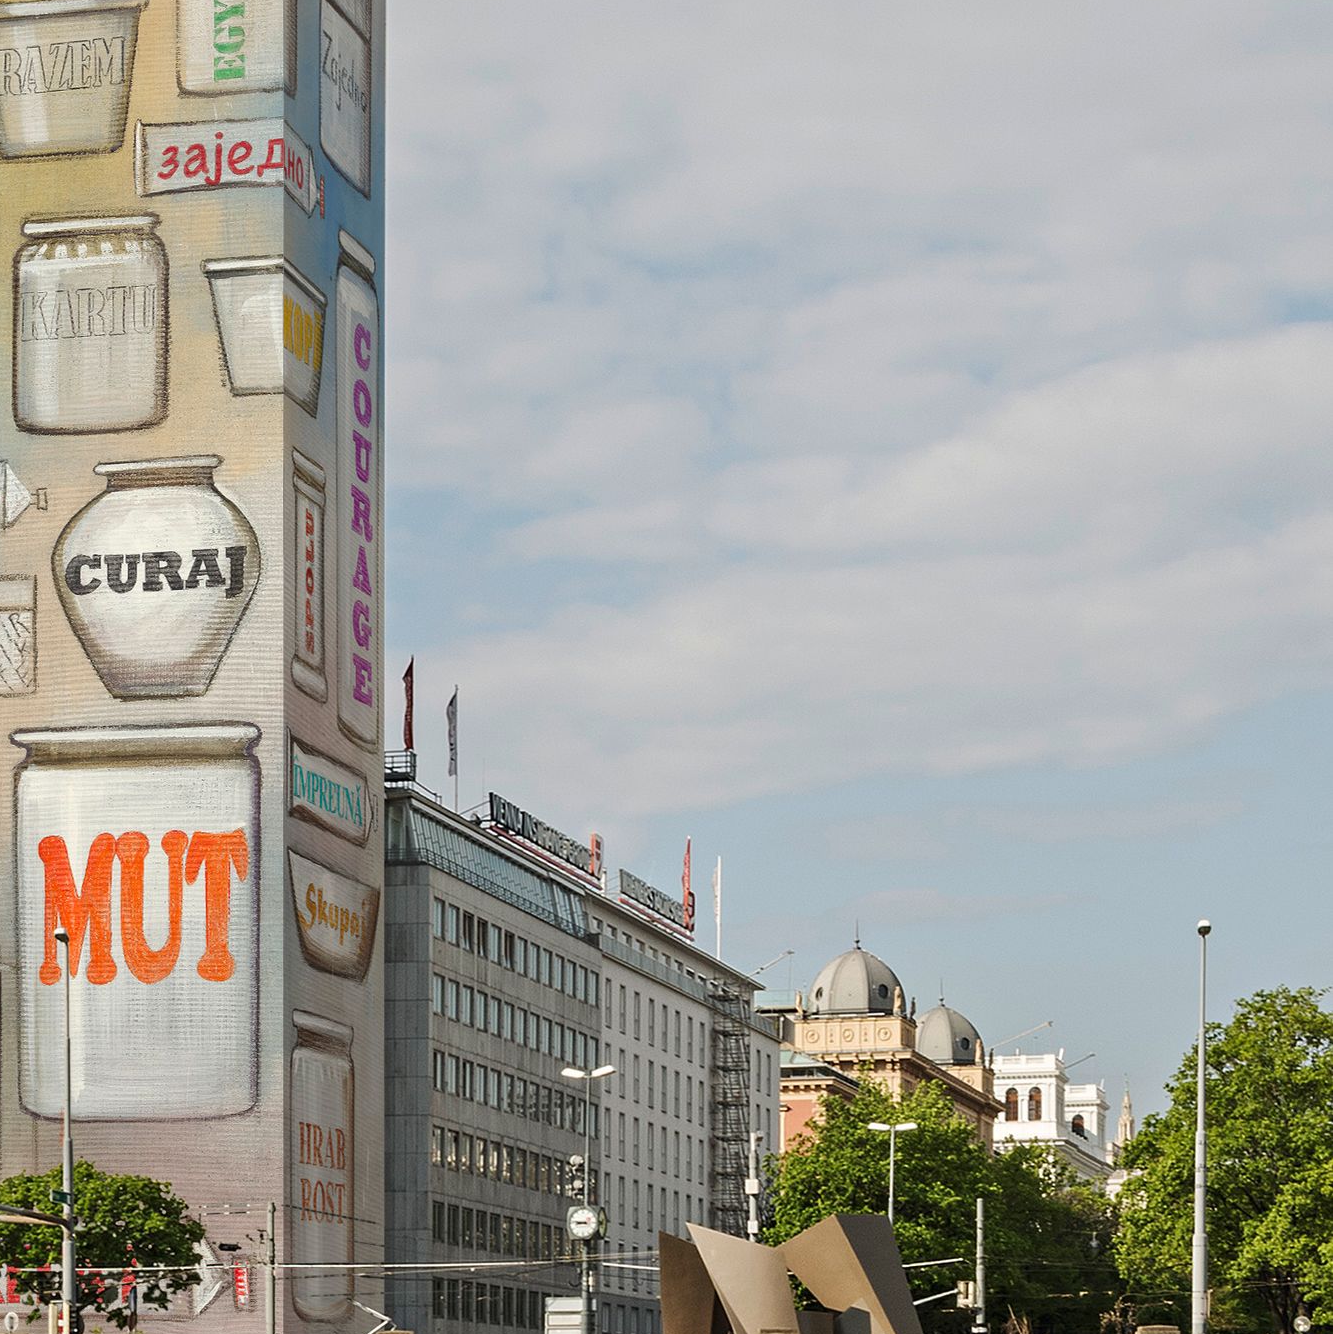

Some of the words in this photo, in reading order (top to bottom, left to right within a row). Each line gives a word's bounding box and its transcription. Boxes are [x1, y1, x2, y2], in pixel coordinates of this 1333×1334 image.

[156, 131, 305, 190] заједно
[21, 284, 158, 342] KARTU
[351, 322, 374, 708] COURAGE
[65, 546, 247, 598] CURAJ
[304, 508, 316, 655] SPOLU
[38, 829, 250, 986] MUT
[299, 1178, 346, 1225] ROST
